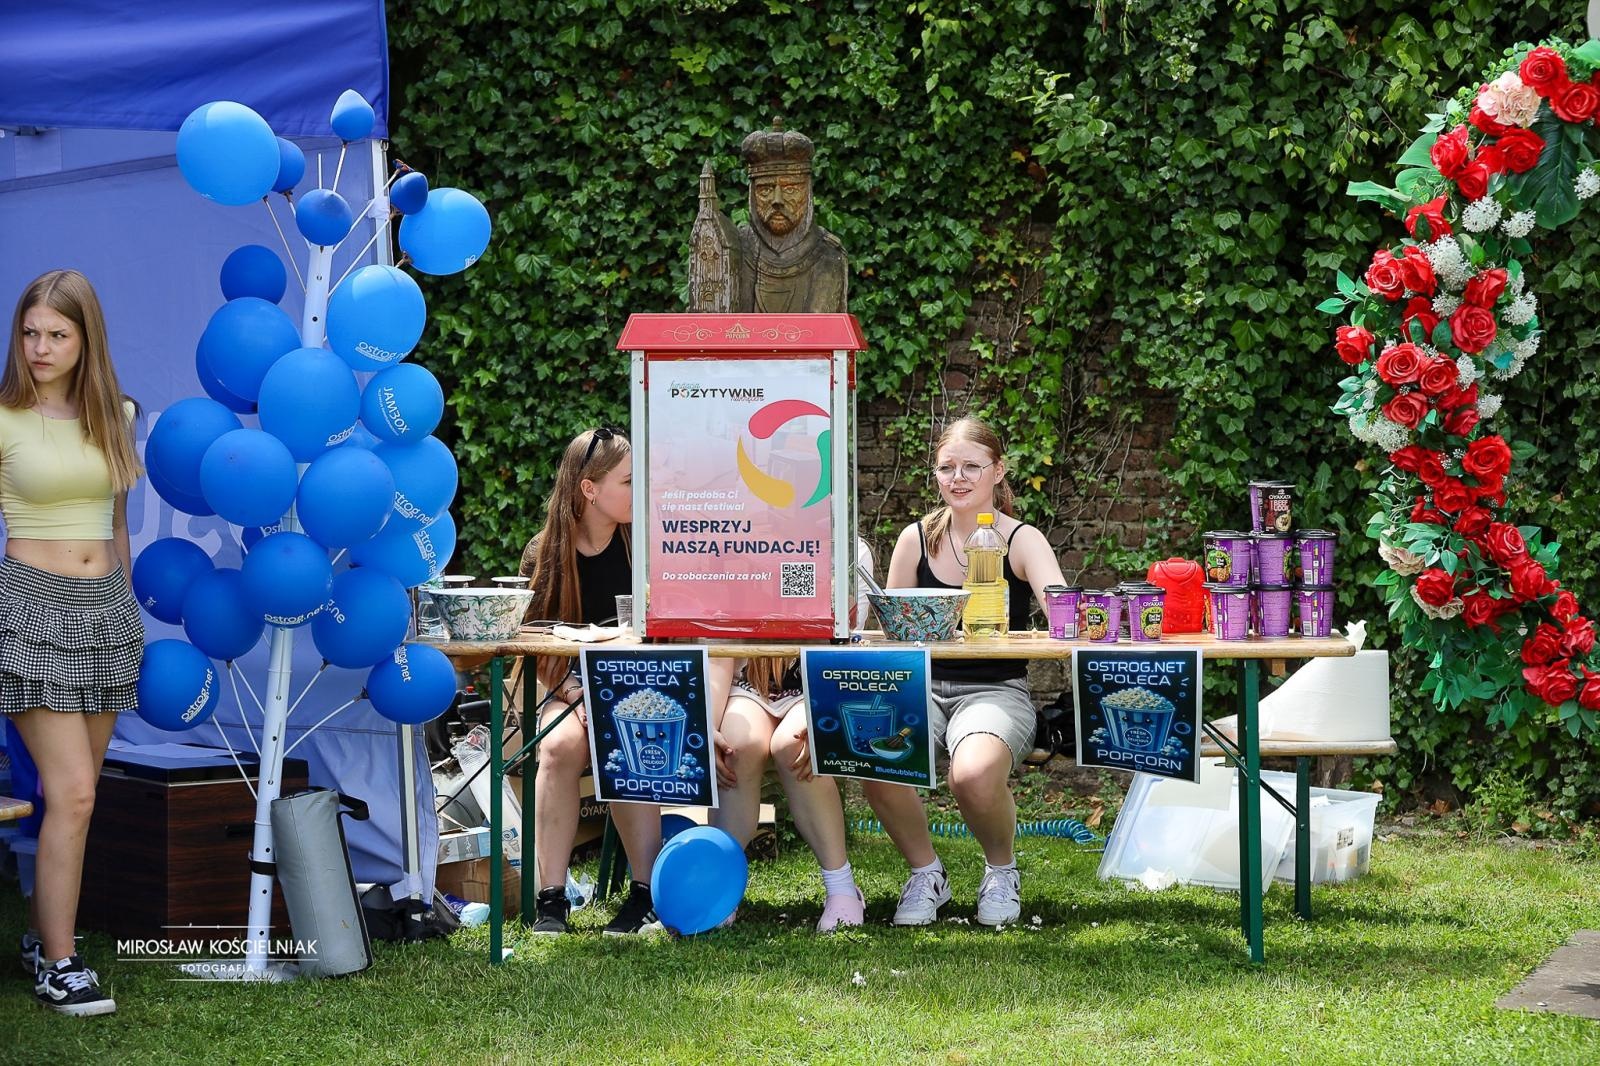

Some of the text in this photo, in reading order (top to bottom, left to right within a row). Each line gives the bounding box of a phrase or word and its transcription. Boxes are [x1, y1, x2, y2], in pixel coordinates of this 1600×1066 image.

[671, 388, 764, 398] POZYTYWNIE
[661, 489, 739, 501] Jeśli podoba Ci
[661, 502, 745, 513] się nasz festiwal
[662, 520, 752, 534] WESPRZYJ
[662, 540, 821, 557] NASZĄ FUNDACJĘ!
[662, 571, 773, 581] Do zobaczenia za rok!
[596, 660, 693, 672] OSTROG.NET
[1087, 661, 1186, 673] OSTROG.NET
[611, 674, 680, 686] POLECA
[822, 670, 913, 681] OSTROG.NET
[1102, 673, 1171, 686] POLECA
[839, 681, 899, 692] POLECA
[823, 759, 871, 768] MATCHA
[1096, 749, 1182, 770] POPCORN
[614, 778, 700, 795] POPCORN
